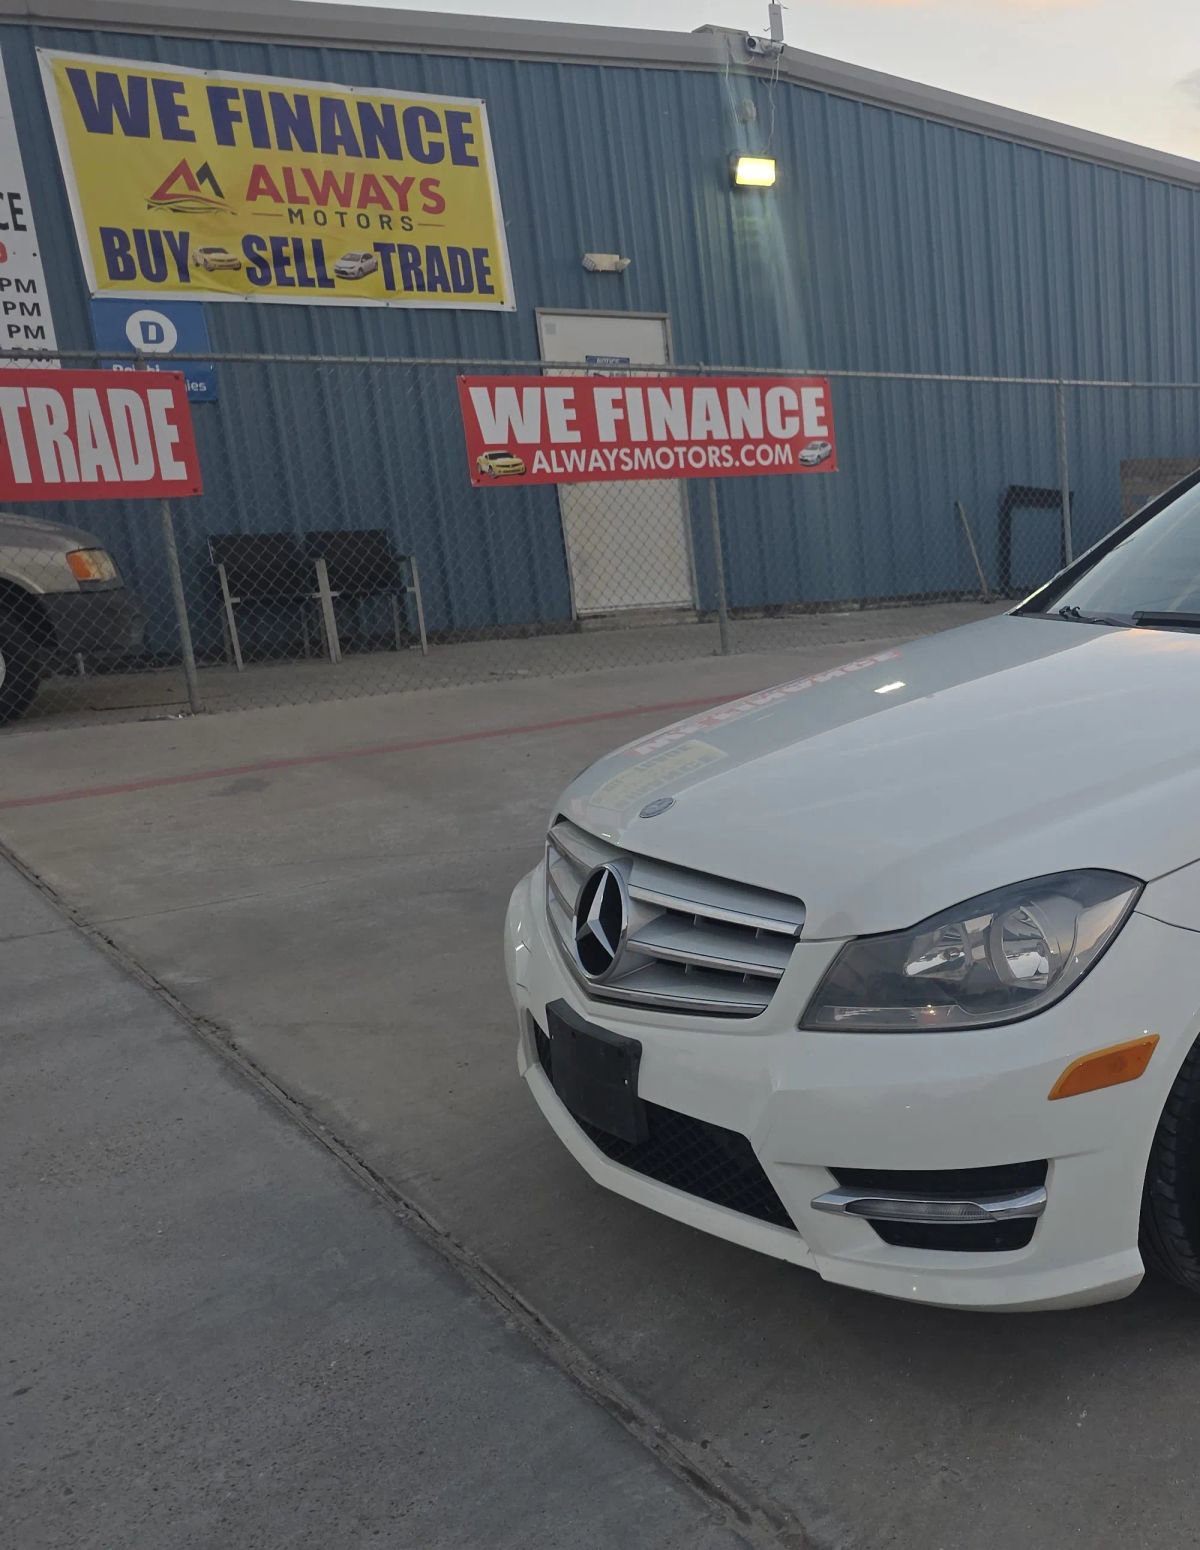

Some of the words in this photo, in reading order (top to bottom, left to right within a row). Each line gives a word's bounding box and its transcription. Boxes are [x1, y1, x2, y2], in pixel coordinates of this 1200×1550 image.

[65, 68, 196, 143] WE
[206, 86, 480, 168] FINANCE
[246, 164, 446, 215] ALWAYS
[287, 208, 414, 232] MOTORS
[99, 227, 191, 283] BUY
[241, 234, 336, 289] SELL
[373, 242, 495, 294] TRADE
[0, 277, 38, 294] PM
[2, 301, 42, 317] PM
[7, 324, 46, 340] PM
[139, 320, 165, 345] D
[468, 386, 582, 445] WE
[592, 386, 829, 443] FINANCE
[0, 386, 188, 484] TRADE
[531, 443, 794, 474] ALWAYSMOTORS.COM
